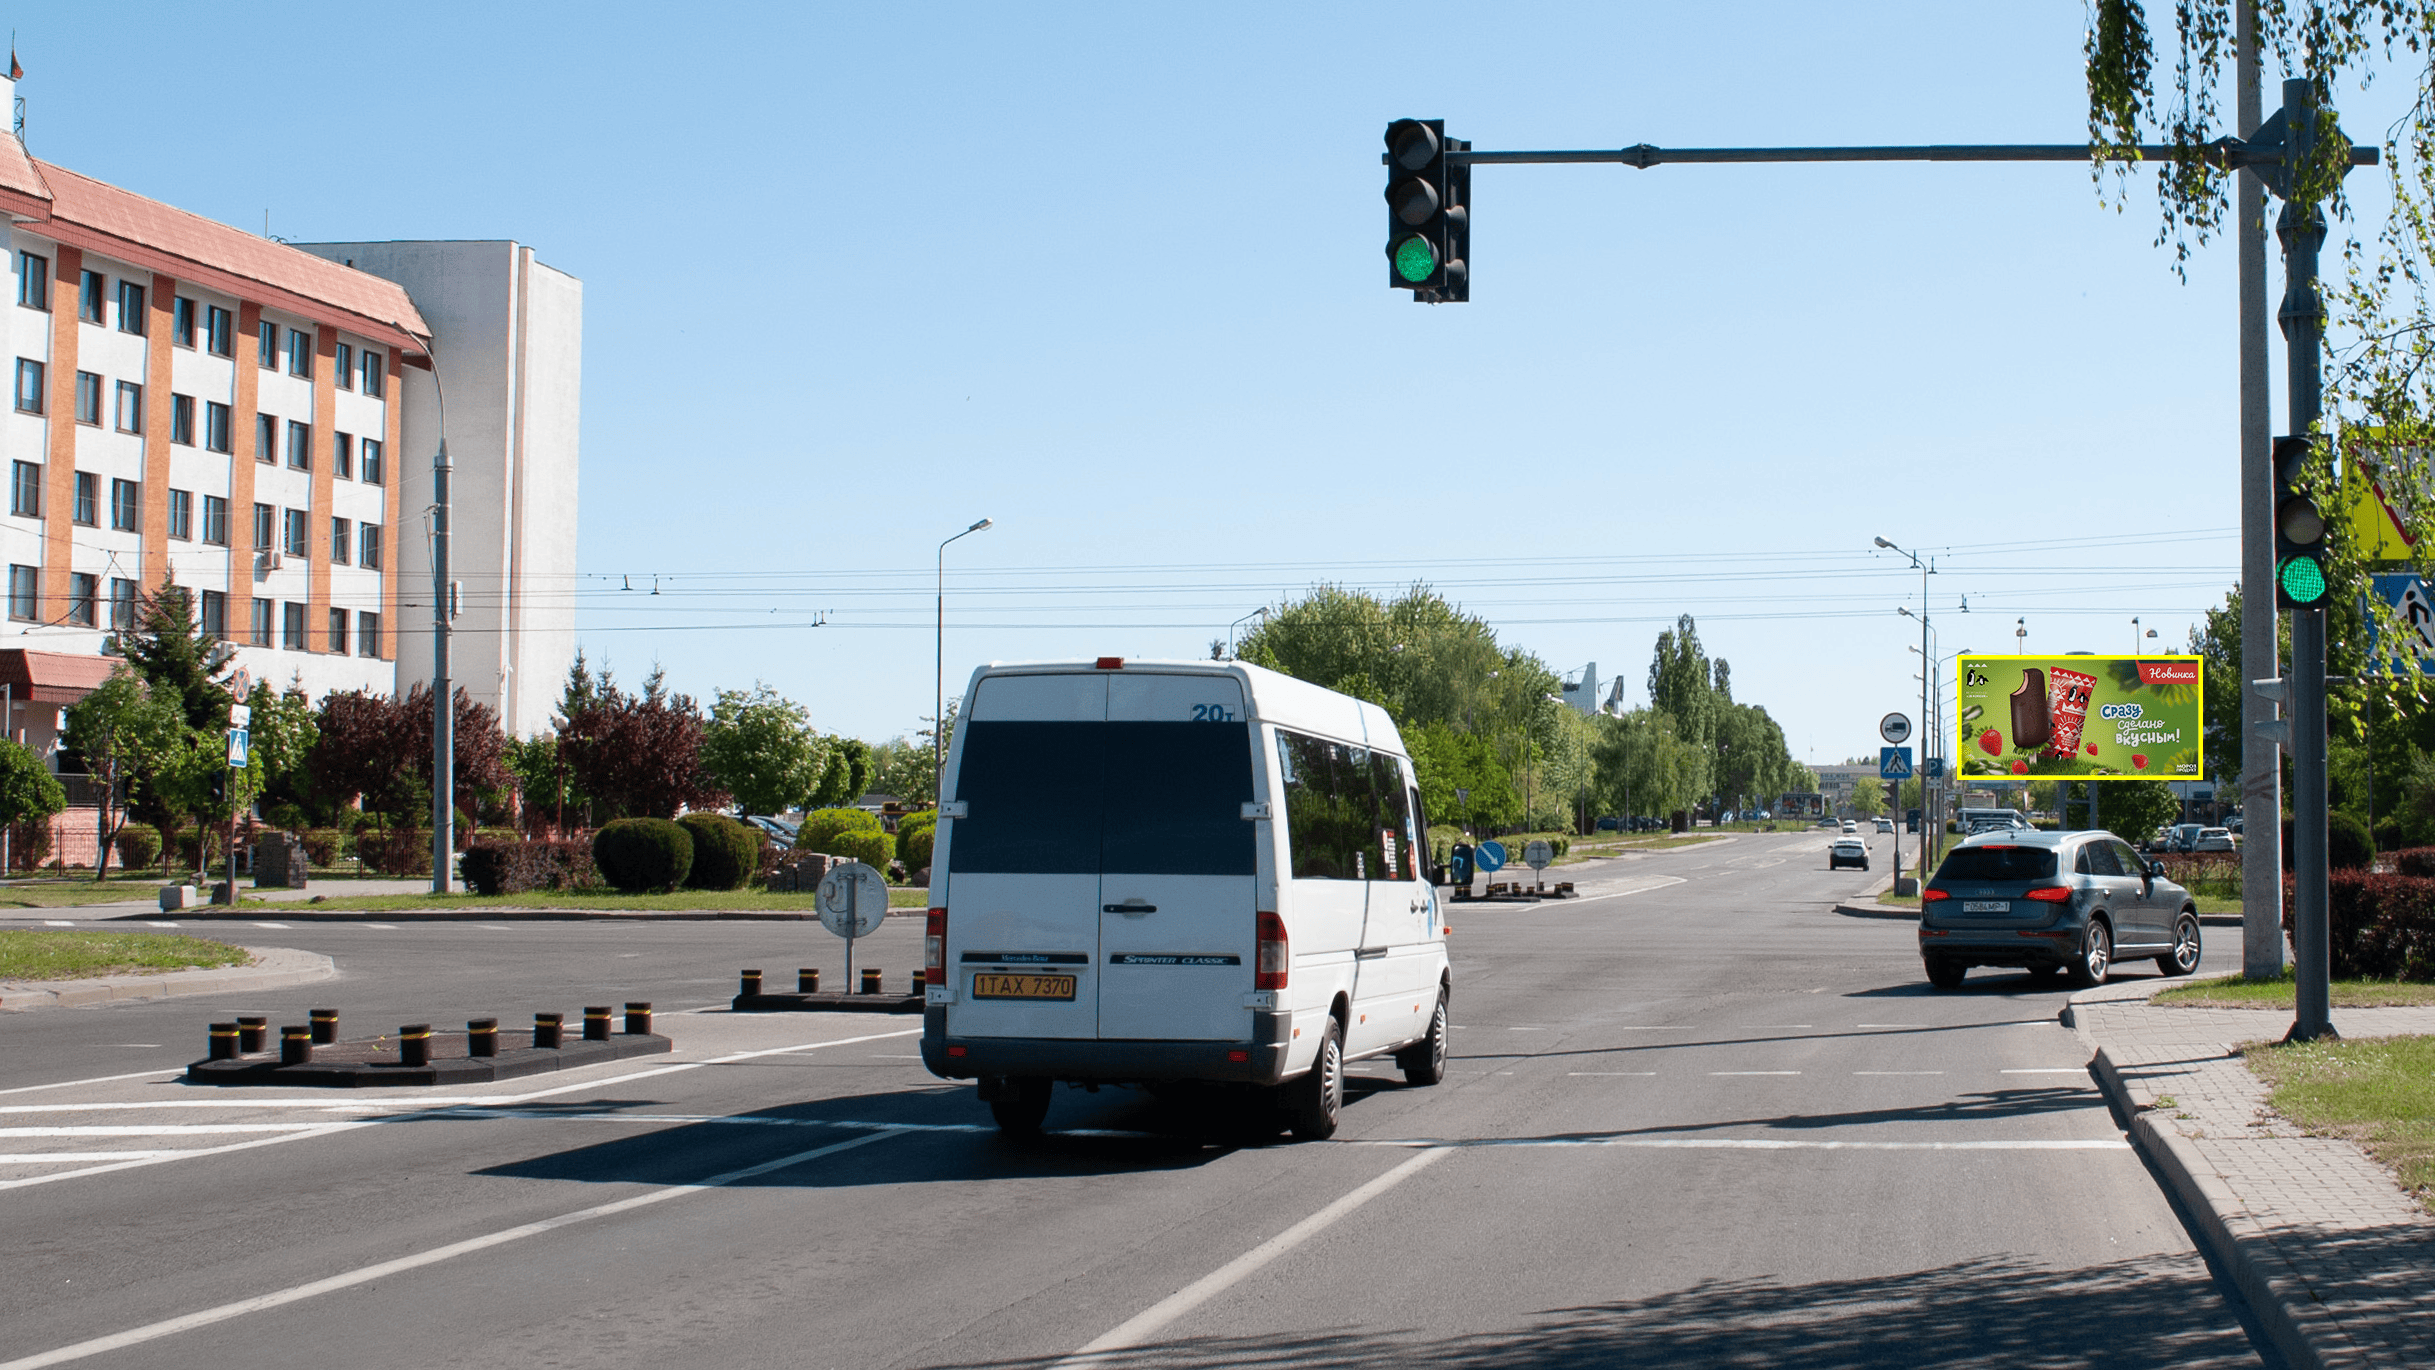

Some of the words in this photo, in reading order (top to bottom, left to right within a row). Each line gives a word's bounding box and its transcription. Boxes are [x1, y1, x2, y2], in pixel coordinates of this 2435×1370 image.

[2149, 667, 2196, 679] Новинка
[2101, 704, 2142, 718] Сразу
[1929, 760, 1938, 774] P
[980, 976, 1024, 994] 1TAX
[1033, 978, 1071, 995] 7370
